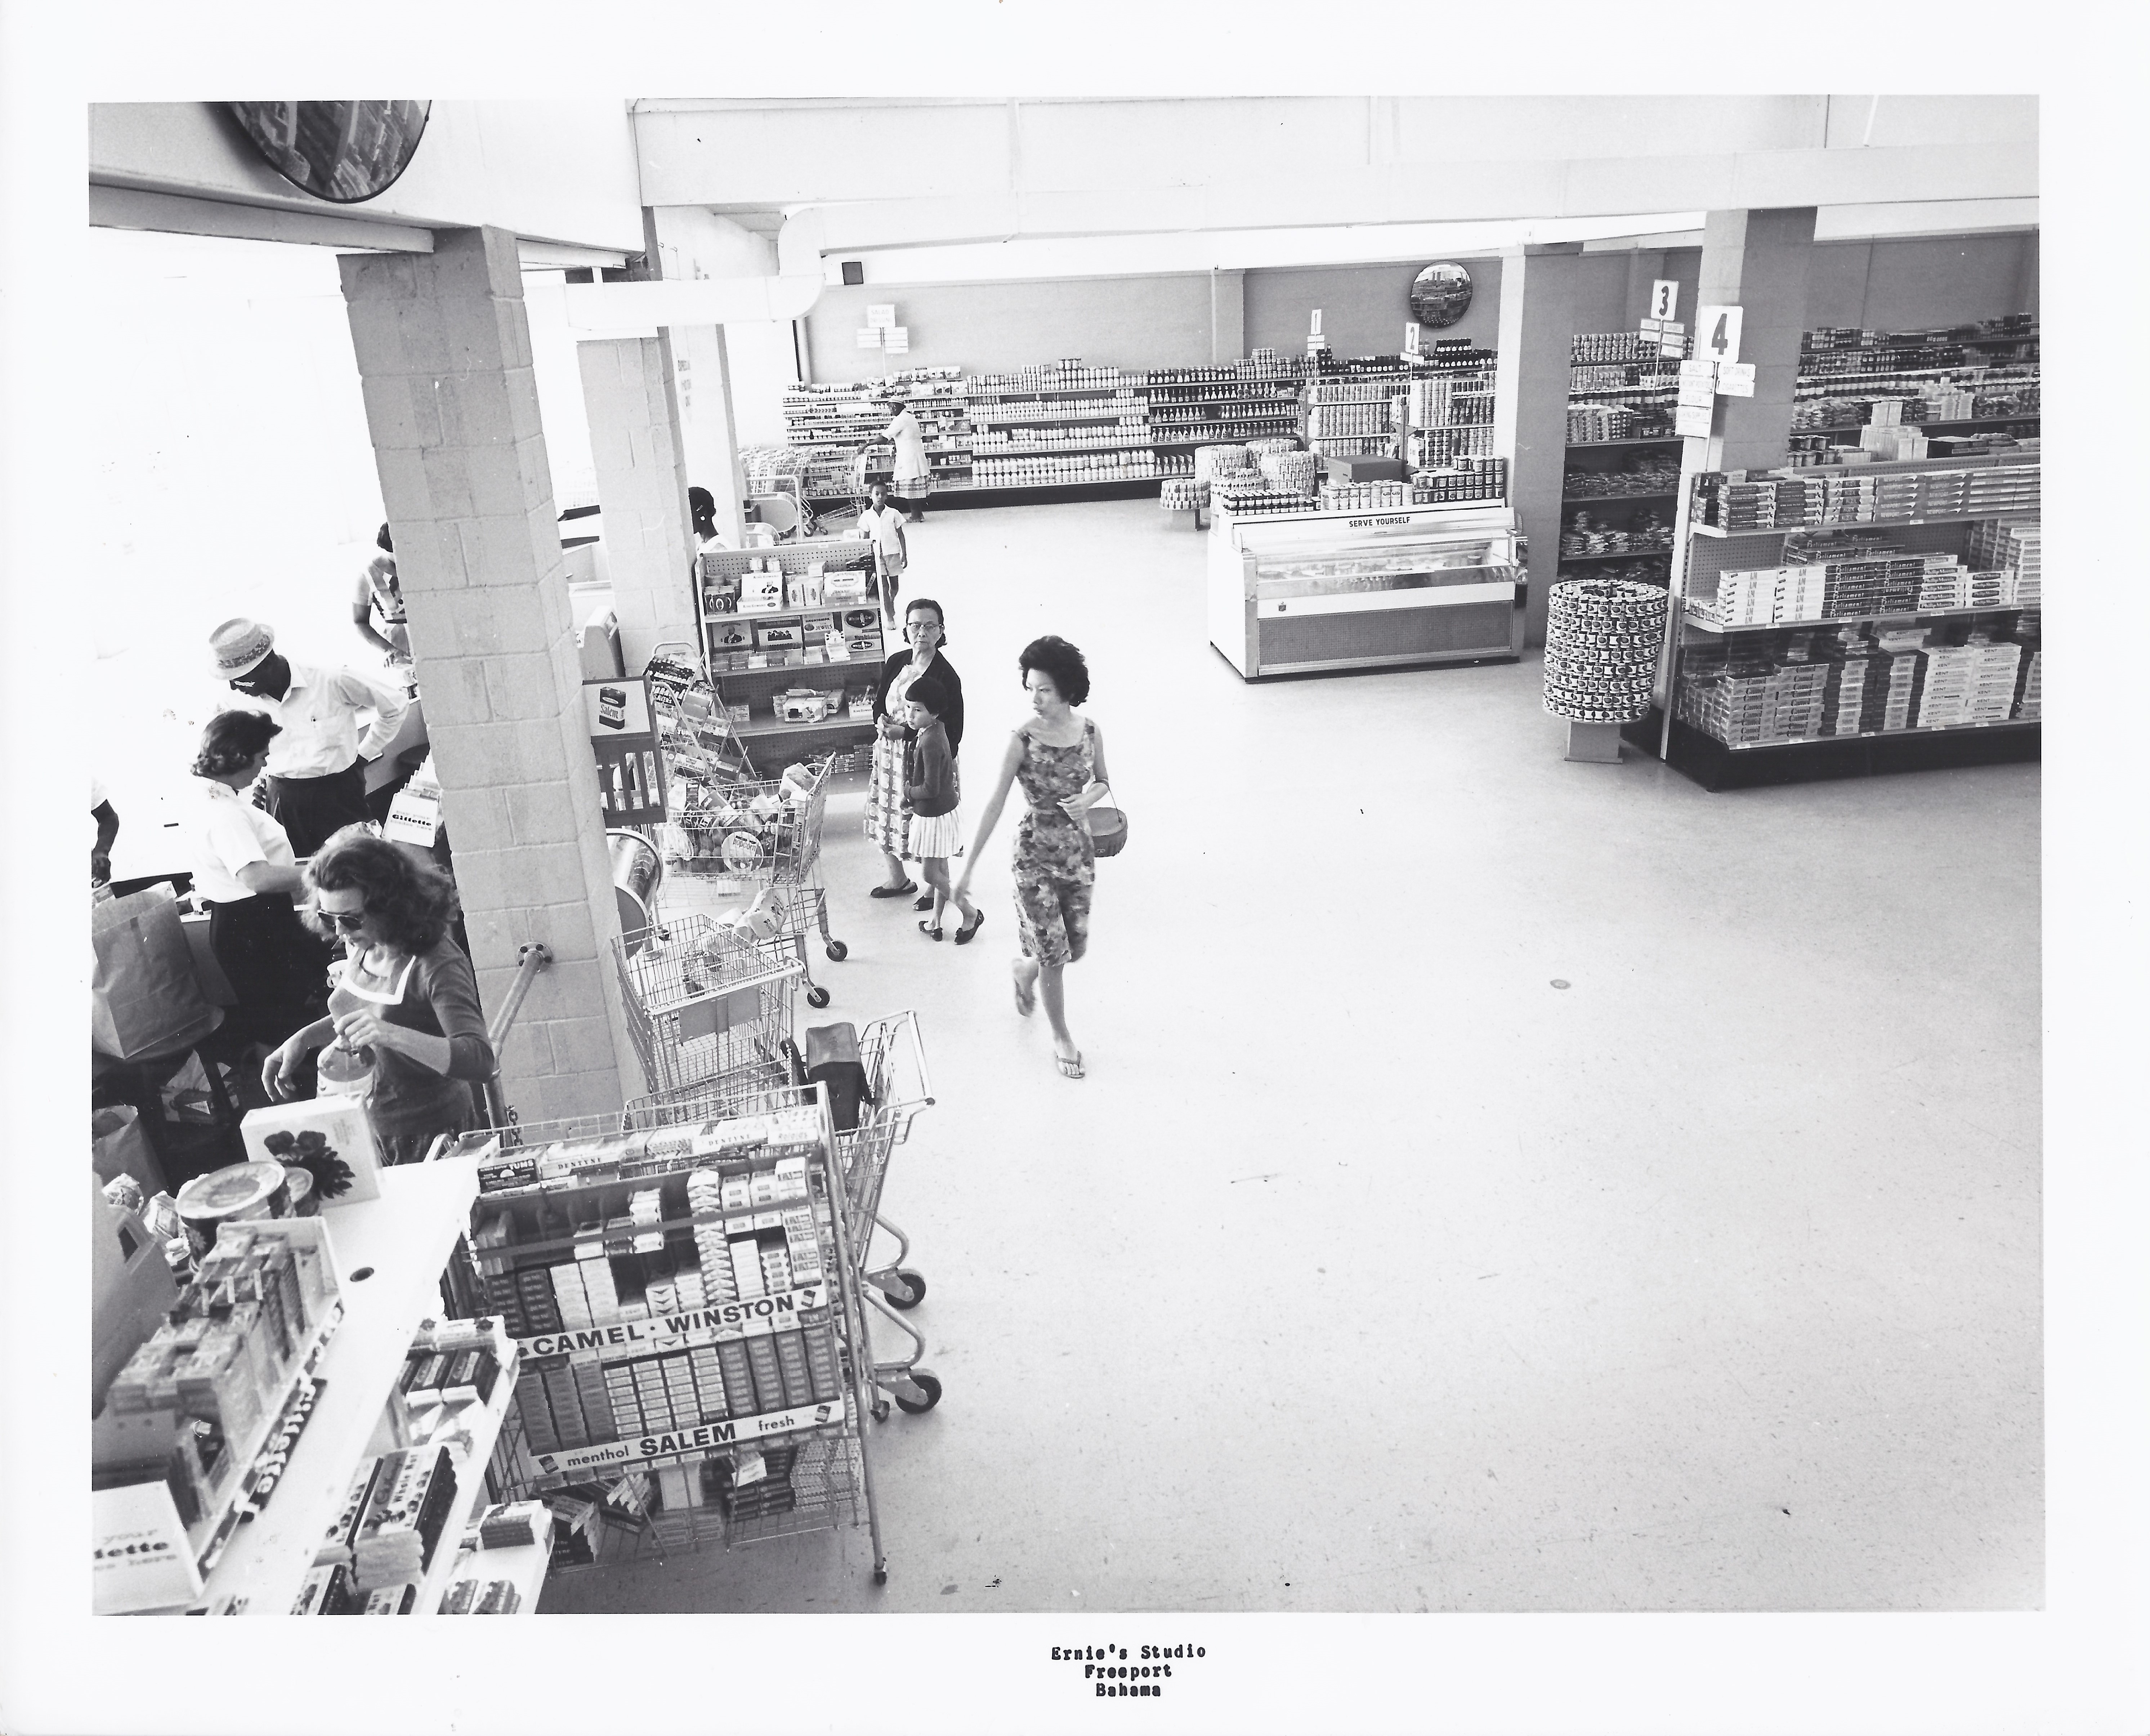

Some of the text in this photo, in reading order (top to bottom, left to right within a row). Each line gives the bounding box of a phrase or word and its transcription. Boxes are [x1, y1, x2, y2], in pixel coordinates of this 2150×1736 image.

[1659, 286, 1669, 316] 3
[1410, 327, 1414, 350] 2
[1711, 313, 1728, 355] 4
[1349, 517, 1410, 527] SERVE YOURSELF
[600, 704, 618, 719] Salem
[392, 814, 431, 826] Gillette
[733, 838, 756, 852] popcorn
[709, 1134, 750, 1145] DENTYNE
[509, 1159, 534, 1170] TUMS
[558, 1158, 601, 1170] DENTYNE
[533, 1294, 794, 1355] CAMEL WINSTON
[567, 1416, 795, 1467] menthol SALEM fresh
